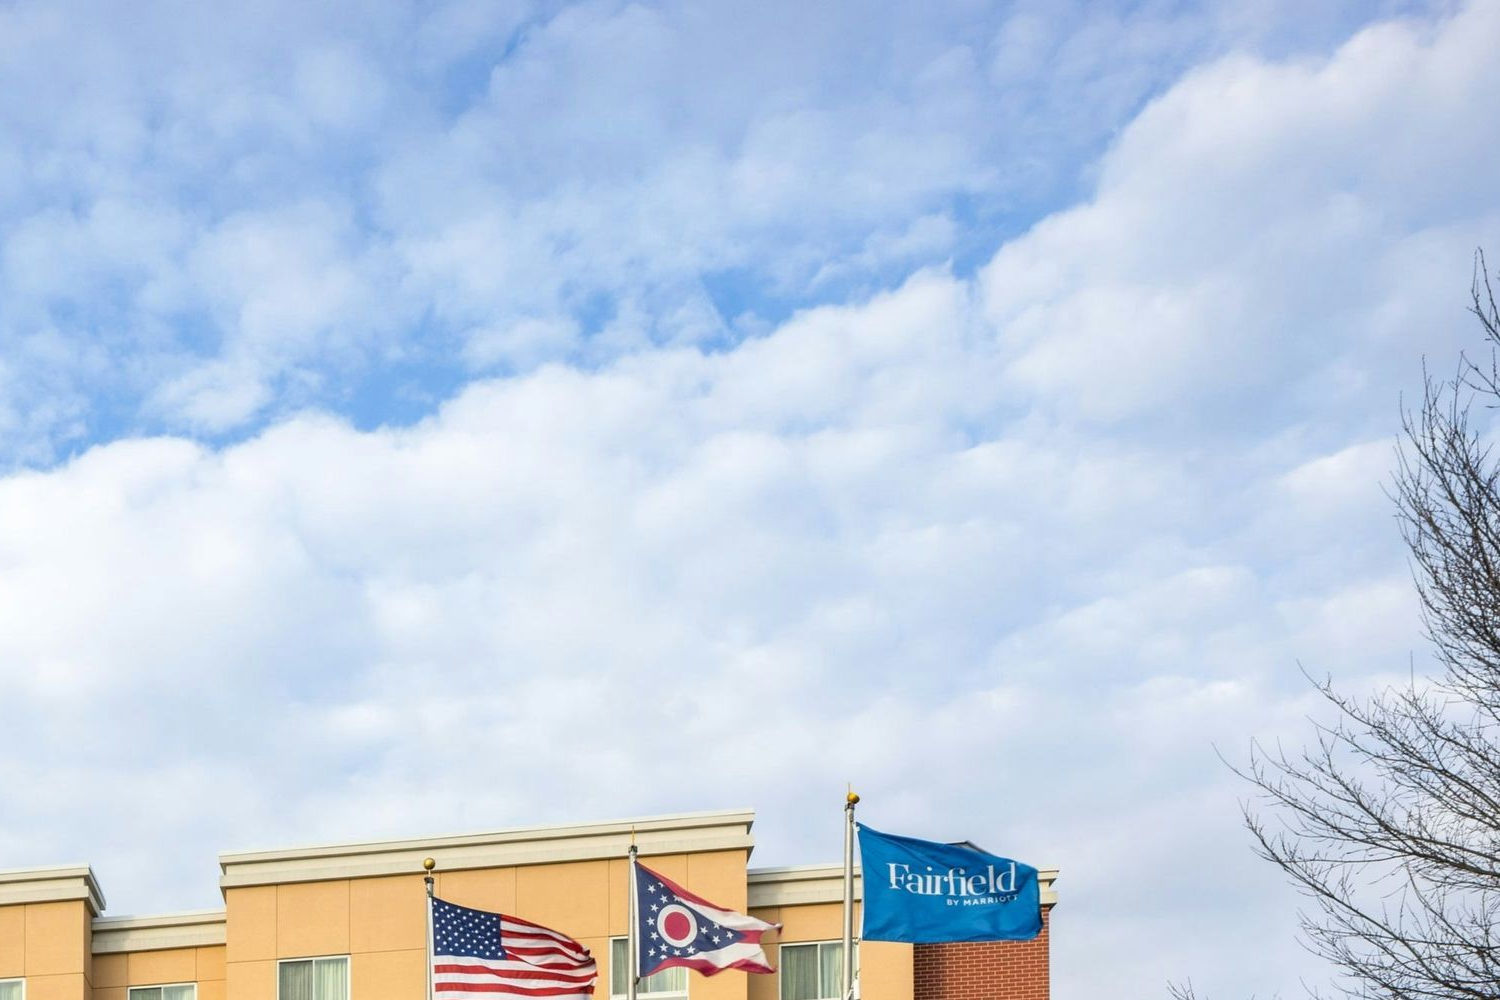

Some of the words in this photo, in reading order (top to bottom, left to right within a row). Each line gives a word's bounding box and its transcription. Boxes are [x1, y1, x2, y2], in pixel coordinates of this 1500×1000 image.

[886, 862, 1018, 897] Fairfield
[946, 898, 960, 906] BY
[963, 894, 1018, 906] MARRIOTT
